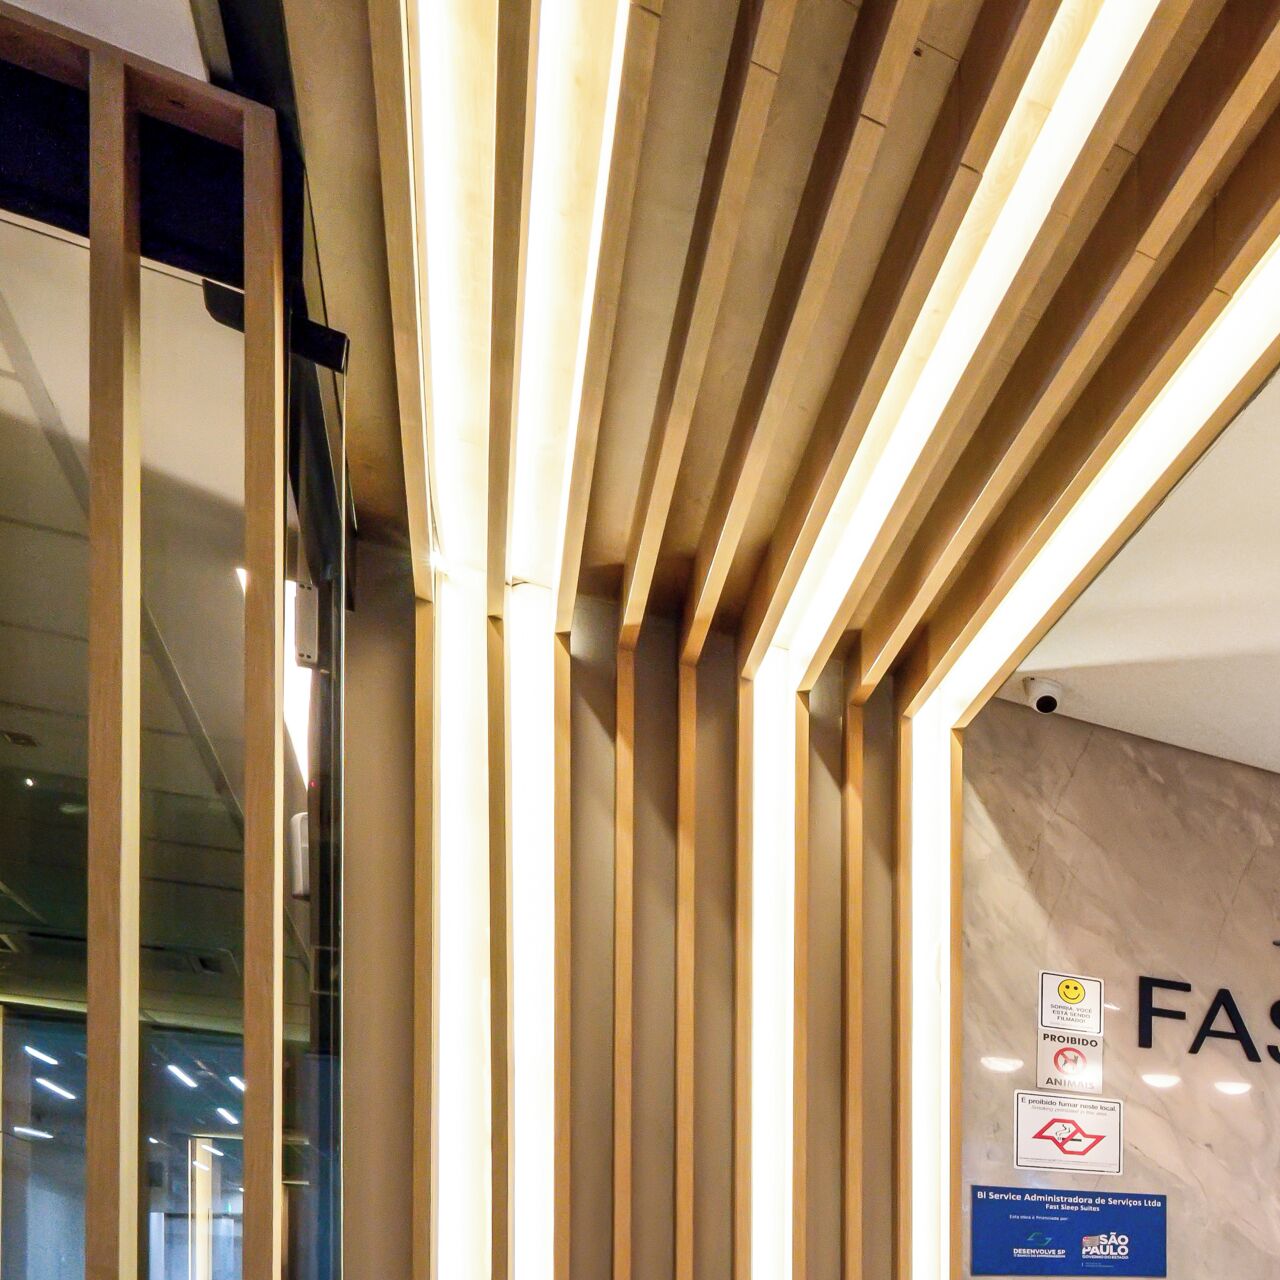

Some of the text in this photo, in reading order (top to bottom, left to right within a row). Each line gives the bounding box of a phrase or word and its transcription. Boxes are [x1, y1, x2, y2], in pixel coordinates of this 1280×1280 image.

[1069, 1011, 1091, 1019] SENDO
[1043, 1033, 1098, 1048] PROIBIDO
[1045, 1077, 1095, 1090] ANIMAIS
[1028, 1098, 1057, 1106] proibido
[1058, 1100, 1078, 1108] fumar
[988, 1192, 1022, 1200] Service
[1024, 1193, 1093, 1204] Administradora
[1095, 1197, 1106, 1205] de
[1108, 1198, 1142, 1207] Serviços
[1144, 1199, 1162, 1207] Ltda
[1061, 1204, 1079, 1212] Sleep
[1099, 1232, 1129, 1245] SÃO
[1081, 1244, 1129, 1256] PAULO
